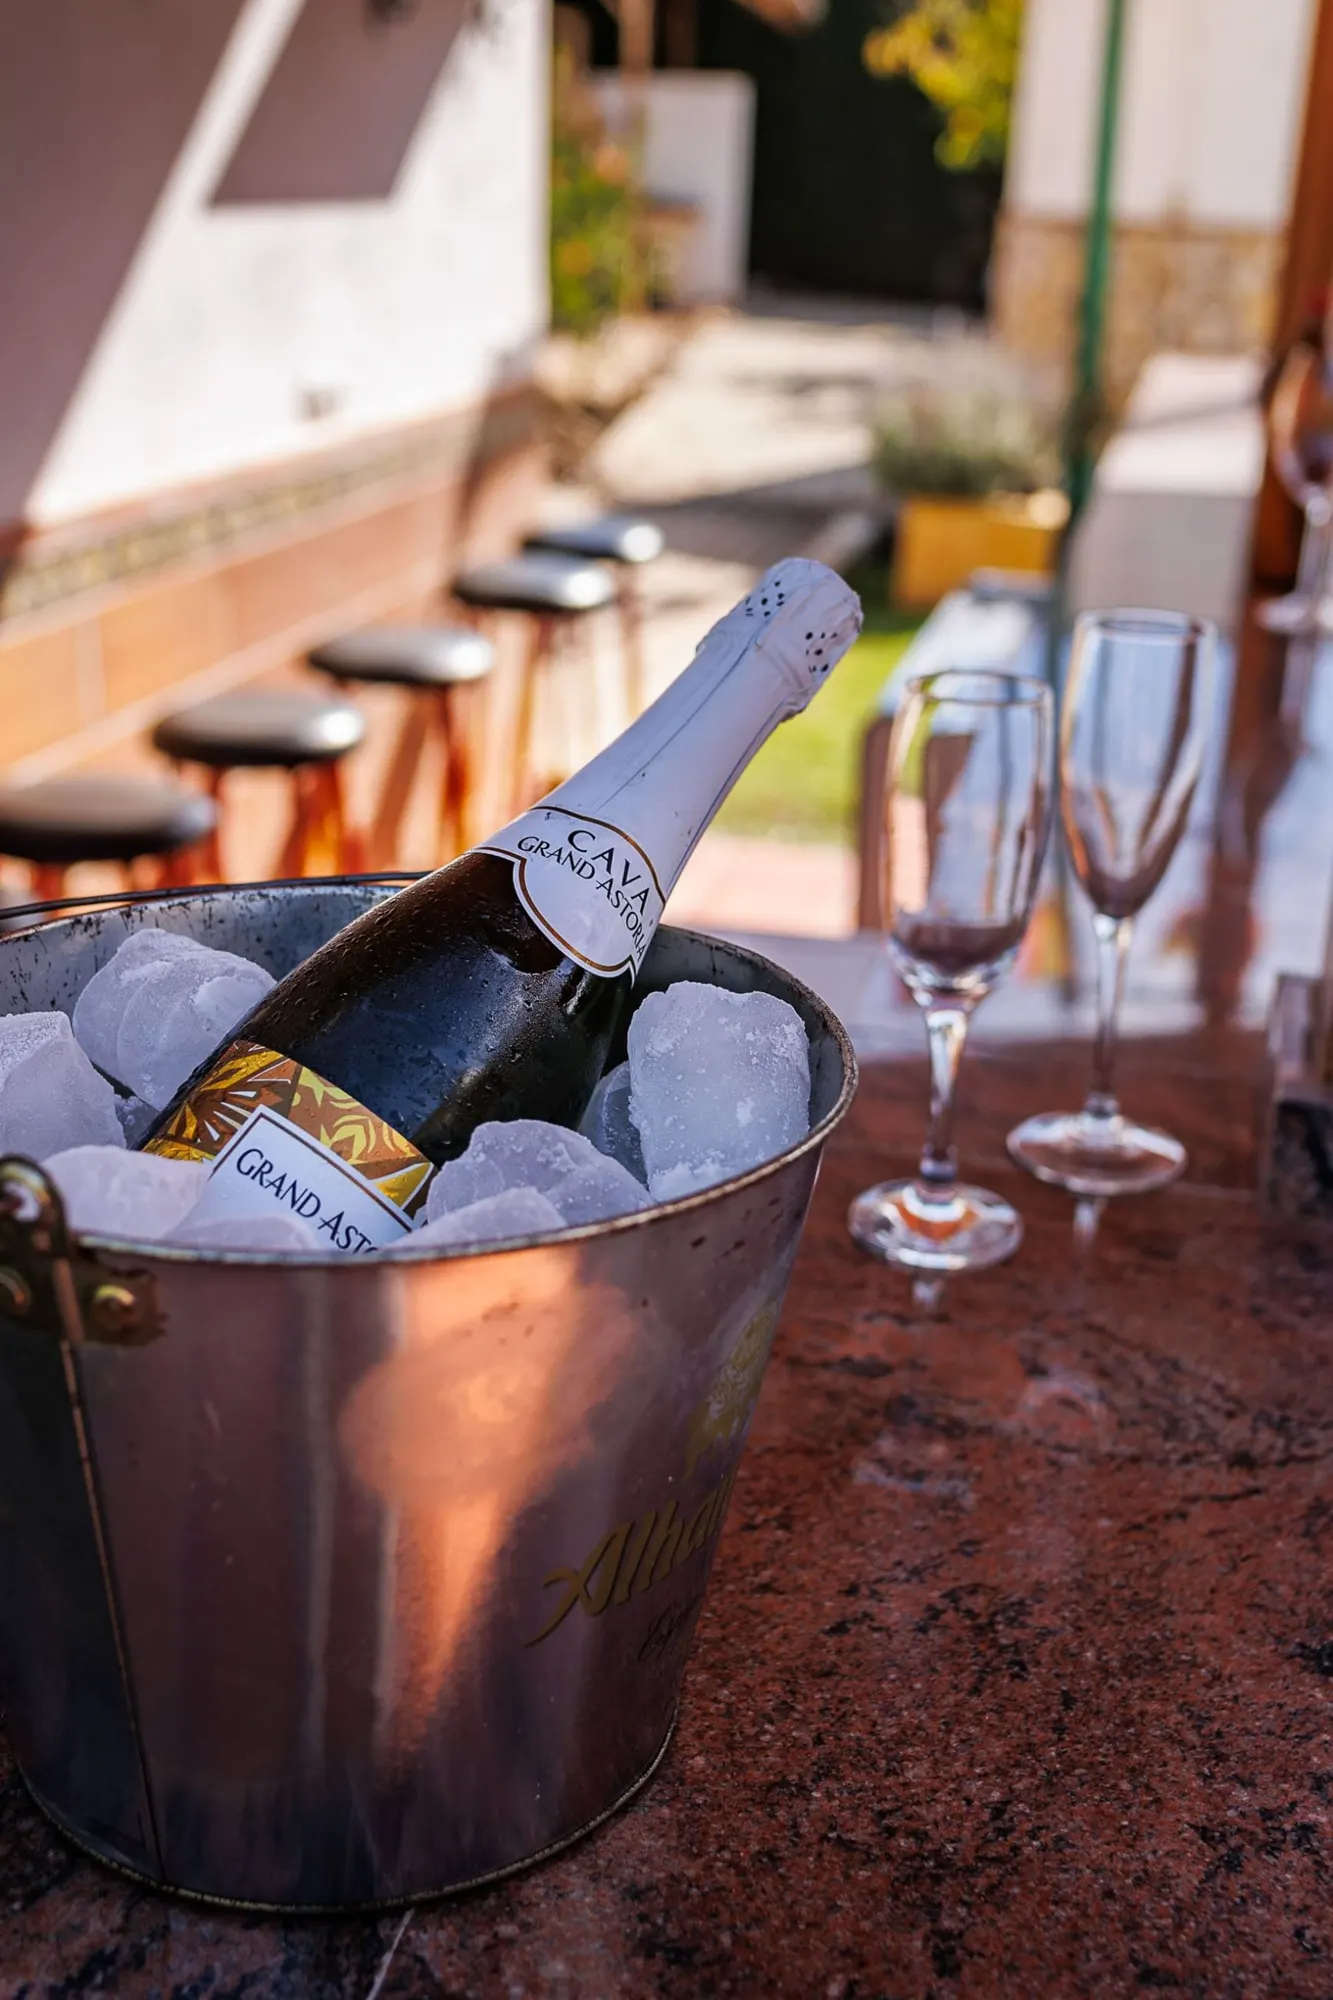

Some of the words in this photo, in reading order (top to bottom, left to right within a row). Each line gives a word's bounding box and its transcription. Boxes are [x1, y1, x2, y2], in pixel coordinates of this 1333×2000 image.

[517, 836, 596, 880] GRAND
[595, 877, 648, 963] ASTORIA
[567, 829, 650, 917] CAVA
[235, 1148, 322, 1219] GRAND
